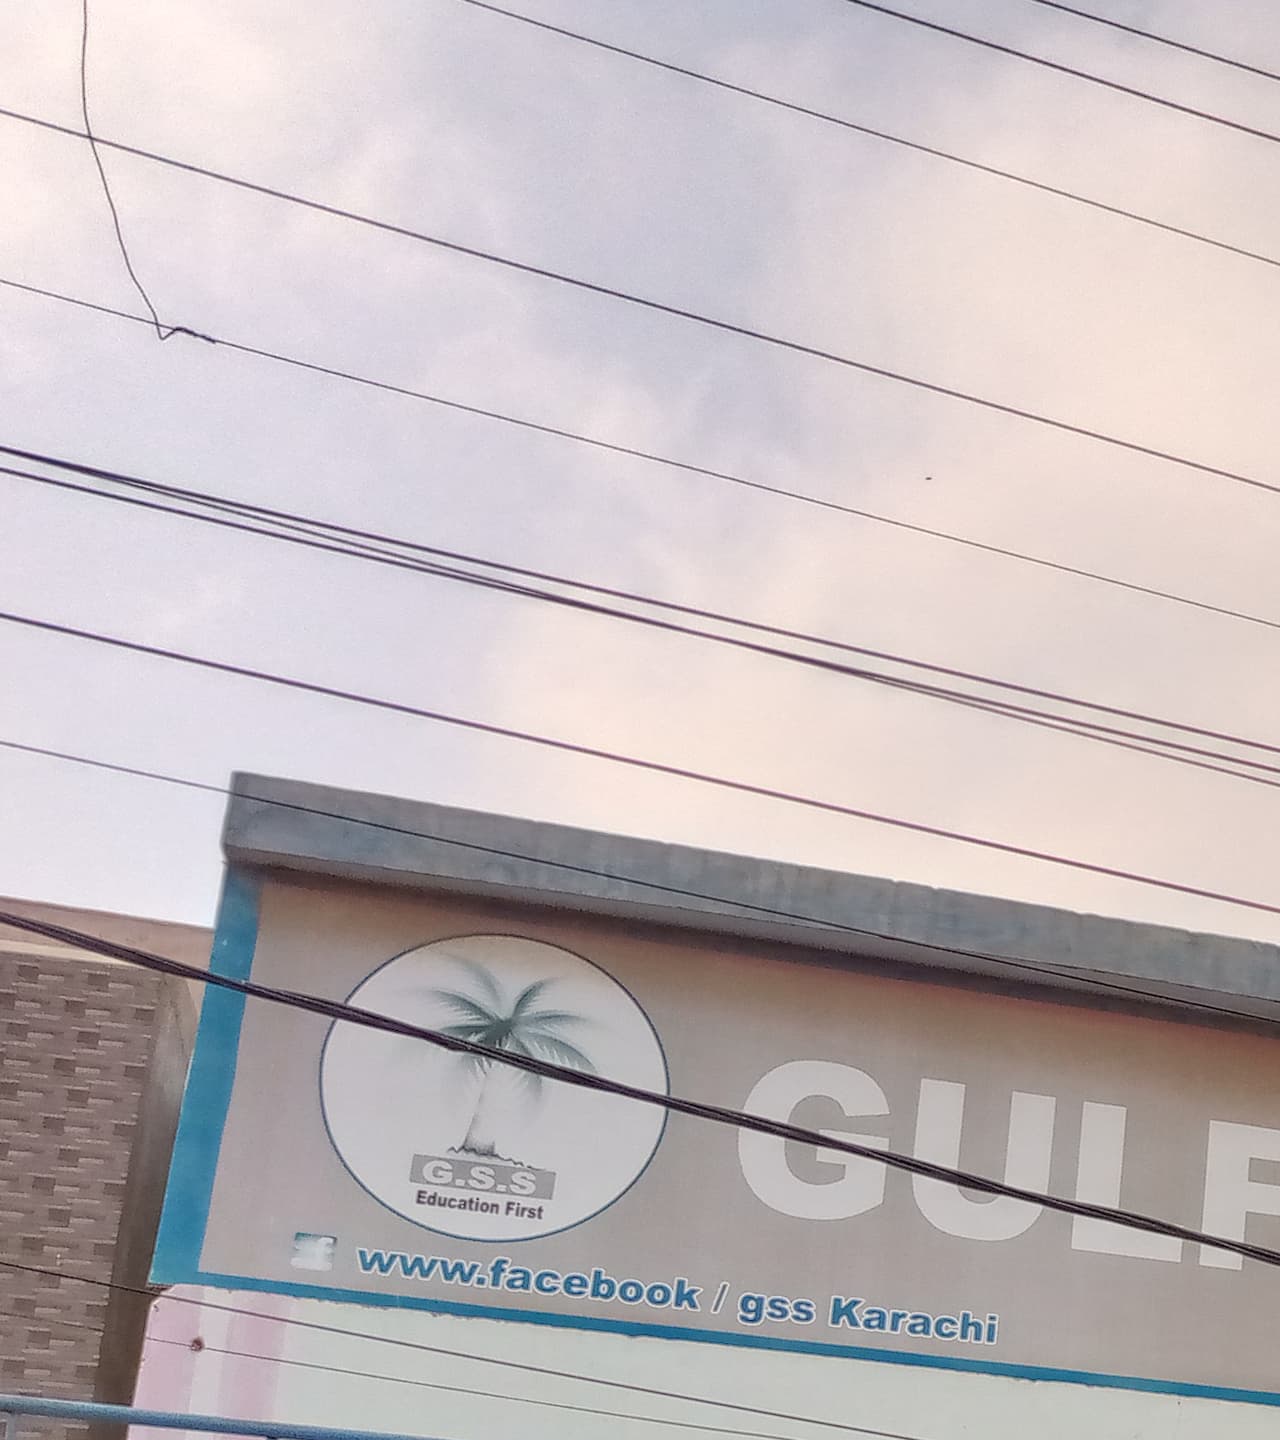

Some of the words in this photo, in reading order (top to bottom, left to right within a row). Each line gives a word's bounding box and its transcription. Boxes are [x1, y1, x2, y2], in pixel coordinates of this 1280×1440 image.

[421, 1159, 537, 1196] G.S.S
[416, 1189, 500, 1216] Education
[504, 1200, 545, 1221] First
[356, 1247, 702, 1312] www.facebook
[737, 1292, 817, 1326] gss
[829, 1295, 1000, 1345] Karachi
